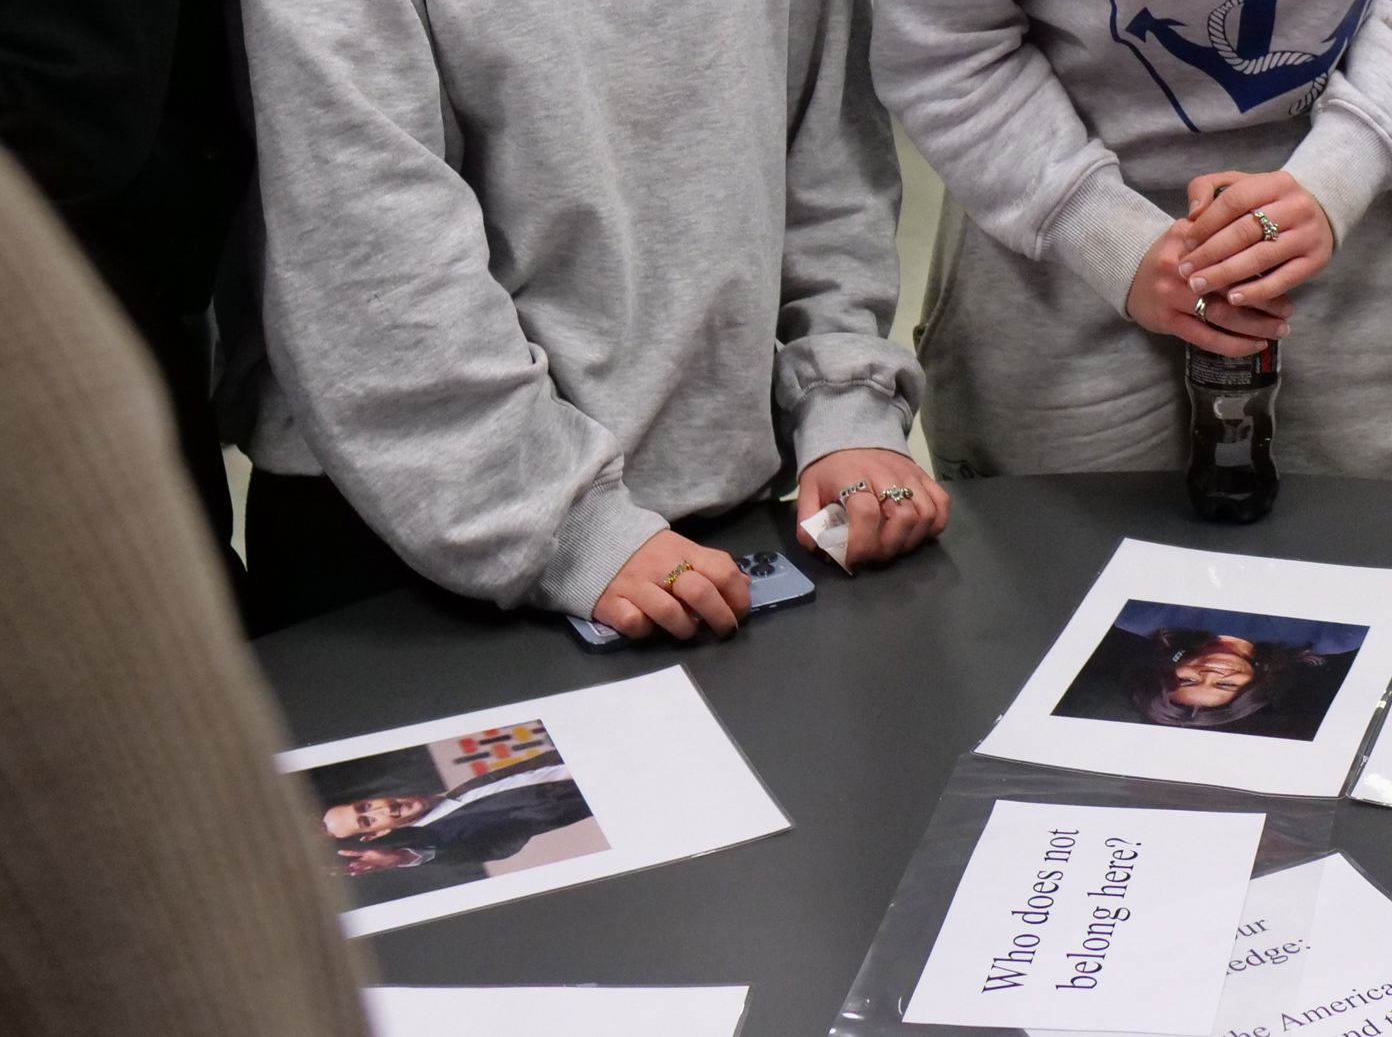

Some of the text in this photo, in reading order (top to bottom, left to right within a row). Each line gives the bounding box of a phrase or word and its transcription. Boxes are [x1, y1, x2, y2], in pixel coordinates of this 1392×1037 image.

[981, 828, 1080, 993] Who does not
[1055, 837, 1142, 991] belong here?
[1226, 938, 1311, 976] edge:
[1235, 918, 1269, 941] ur
